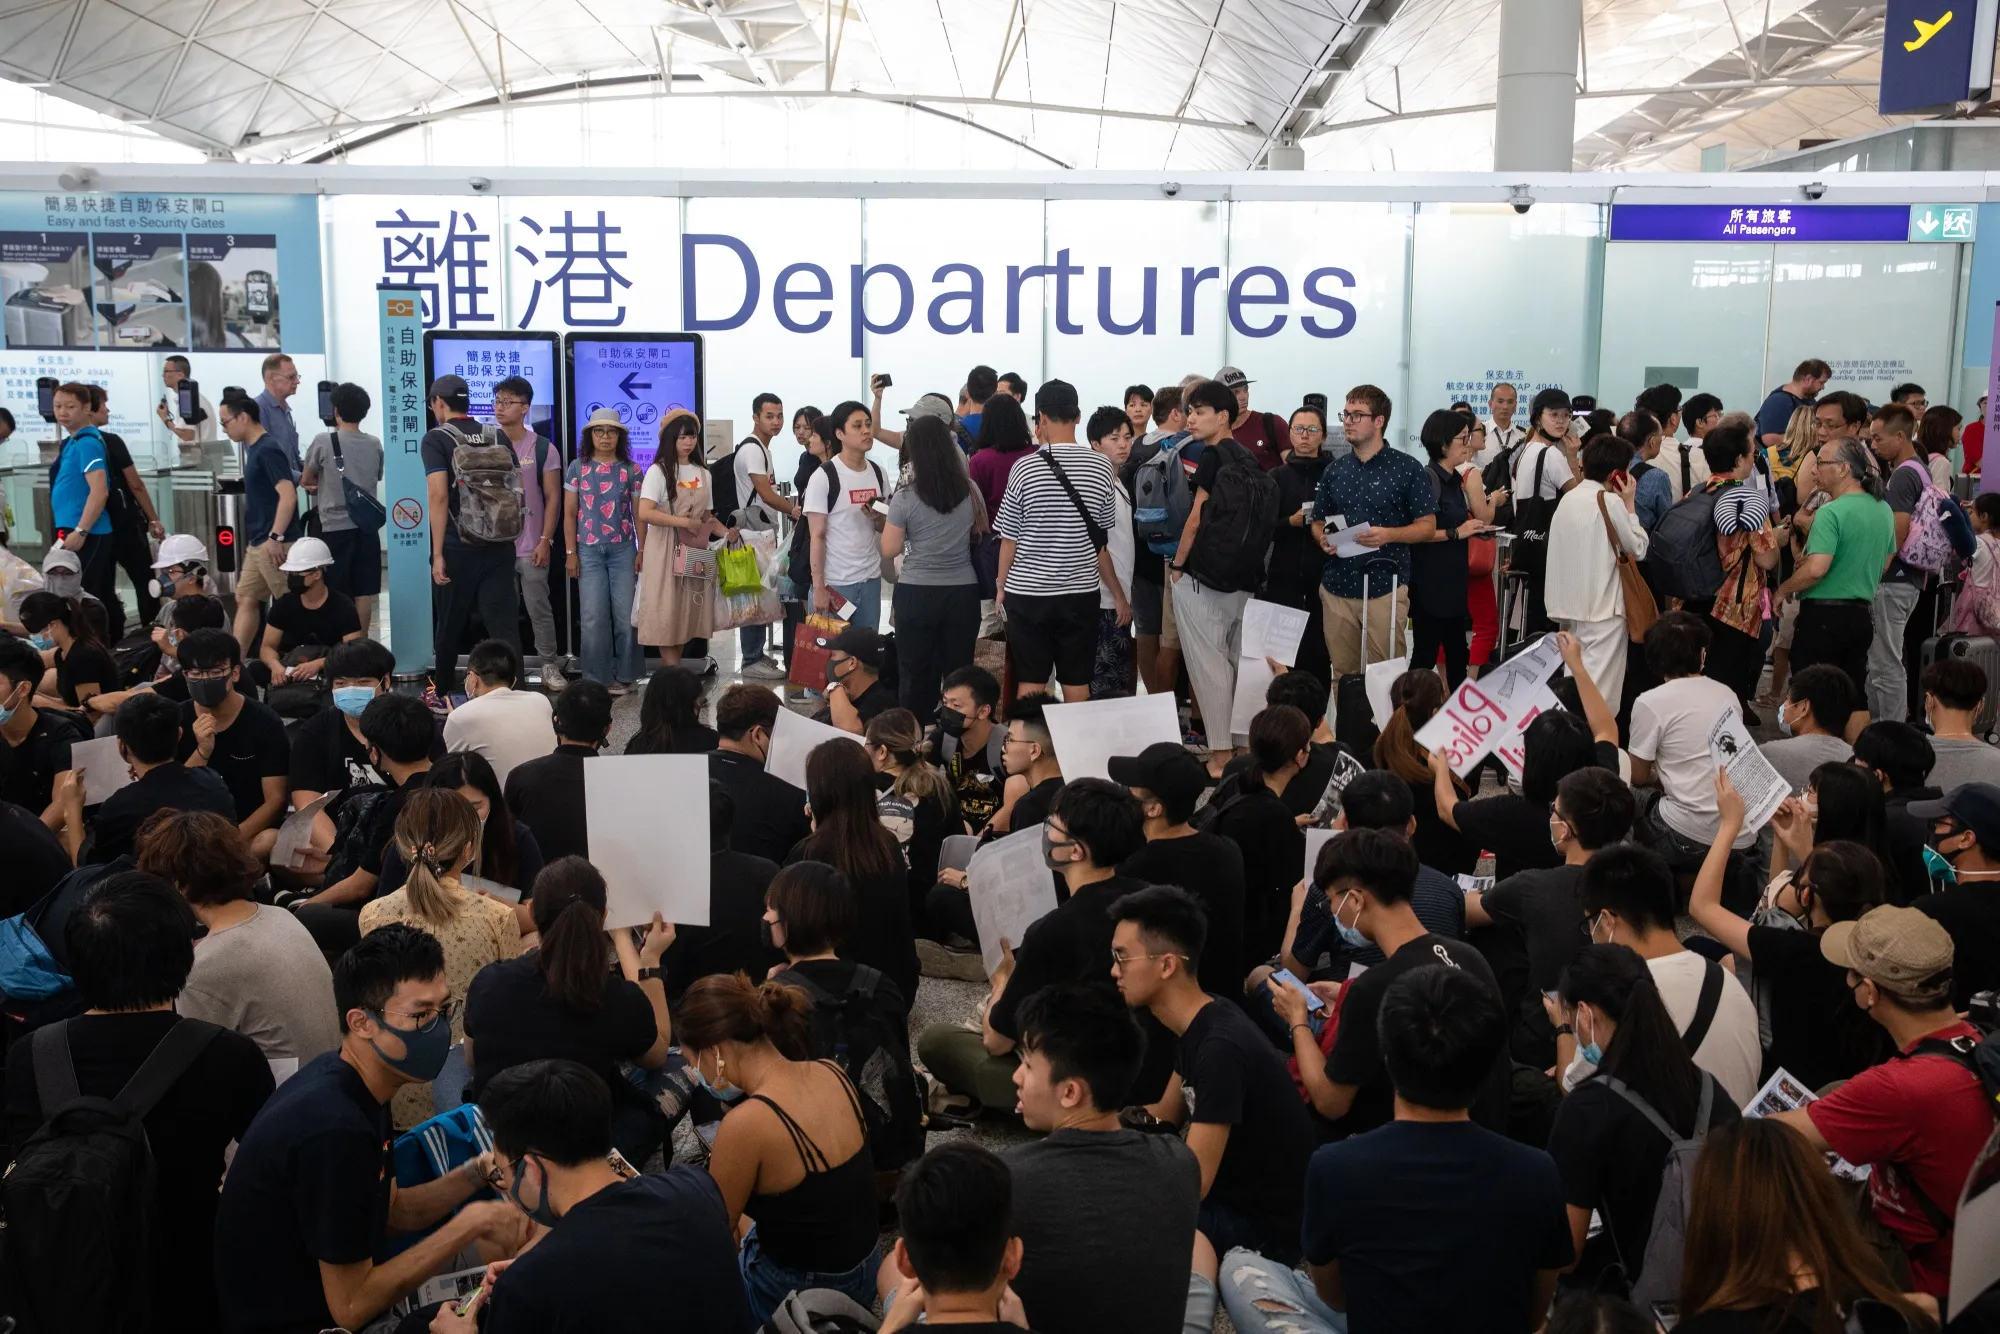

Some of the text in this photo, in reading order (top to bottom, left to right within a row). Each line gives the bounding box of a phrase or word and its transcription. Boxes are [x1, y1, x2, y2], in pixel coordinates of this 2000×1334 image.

[44, 196, 225, 214] 簡易快捷自助保安閘口
[1729, 208, 1791, 223] 所有旅客
[47, 215, 225, 230] Easy and fast e-Security Gates
[1723, 224, 1796, 237] All Passengers
[40, 232, 48, 244] 1
[133, 234, 142, 245] 2
[226, 235, 235, 246] 3
[376, 208, 1357, 358] 離港 Departures
[467, 350, 521, 363] 簡易快捷
[598, 347, 671, 359] 自助保安閘口
[454, 364, 534, 377] 自助保安閘口
[601, 360, 668, 370] e-Security Gates
[1486, 370, 1524, 380] 保安告示
[400, 326, 418, 454] 自助保安閘口
[1446, 382, 1494, 391] 航空保安規
[1535, 382, 1563, 391] 494A)
[1523, 530, 1546, 542] Mad
